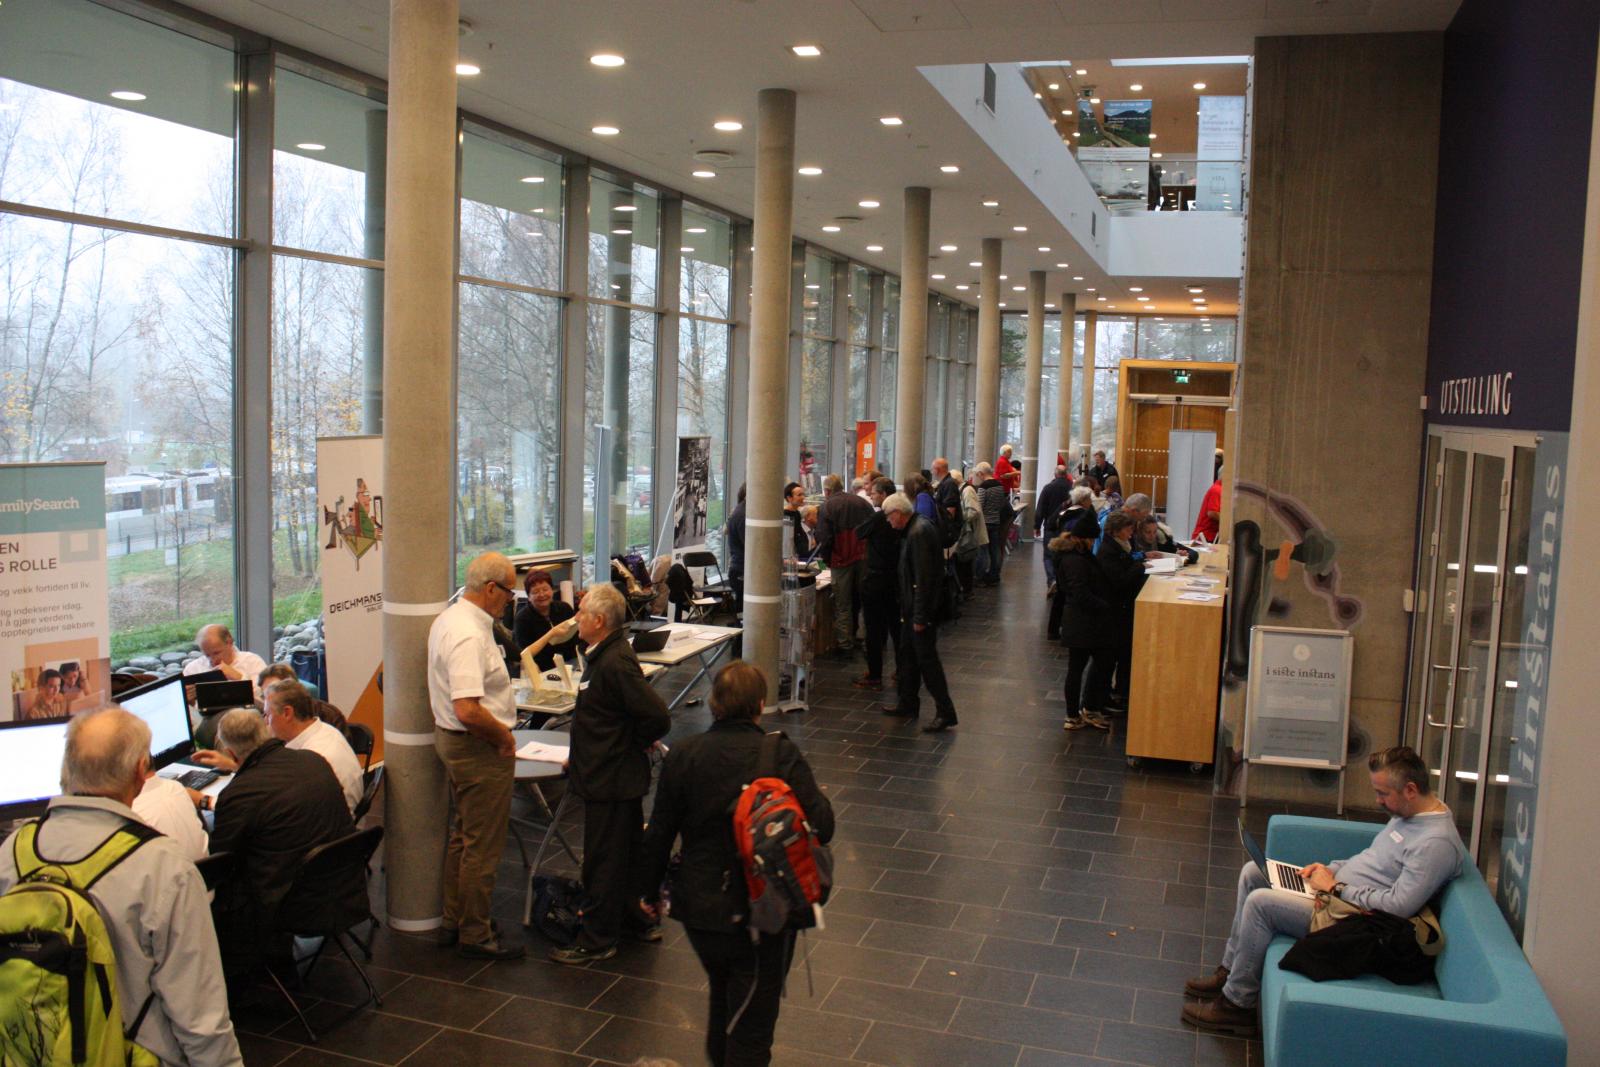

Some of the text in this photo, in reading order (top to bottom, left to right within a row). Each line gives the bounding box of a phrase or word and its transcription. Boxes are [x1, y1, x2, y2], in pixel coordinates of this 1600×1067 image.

[1440, 372, 1512, 415] UTSTILLING
[0, 497, 80, 514] milySearch
[10, 558, 57, 573] ROLLE
[35, 583, 69, 593] fortiden
[14, 605, 60, 615] indekserer
[329, 592, 383, 613] DEICHMANS
[13, 617, 37, 627] gjøre
[38, 613, 73, 623] verdens
[1503, 464, 1560, 920] ste instans
